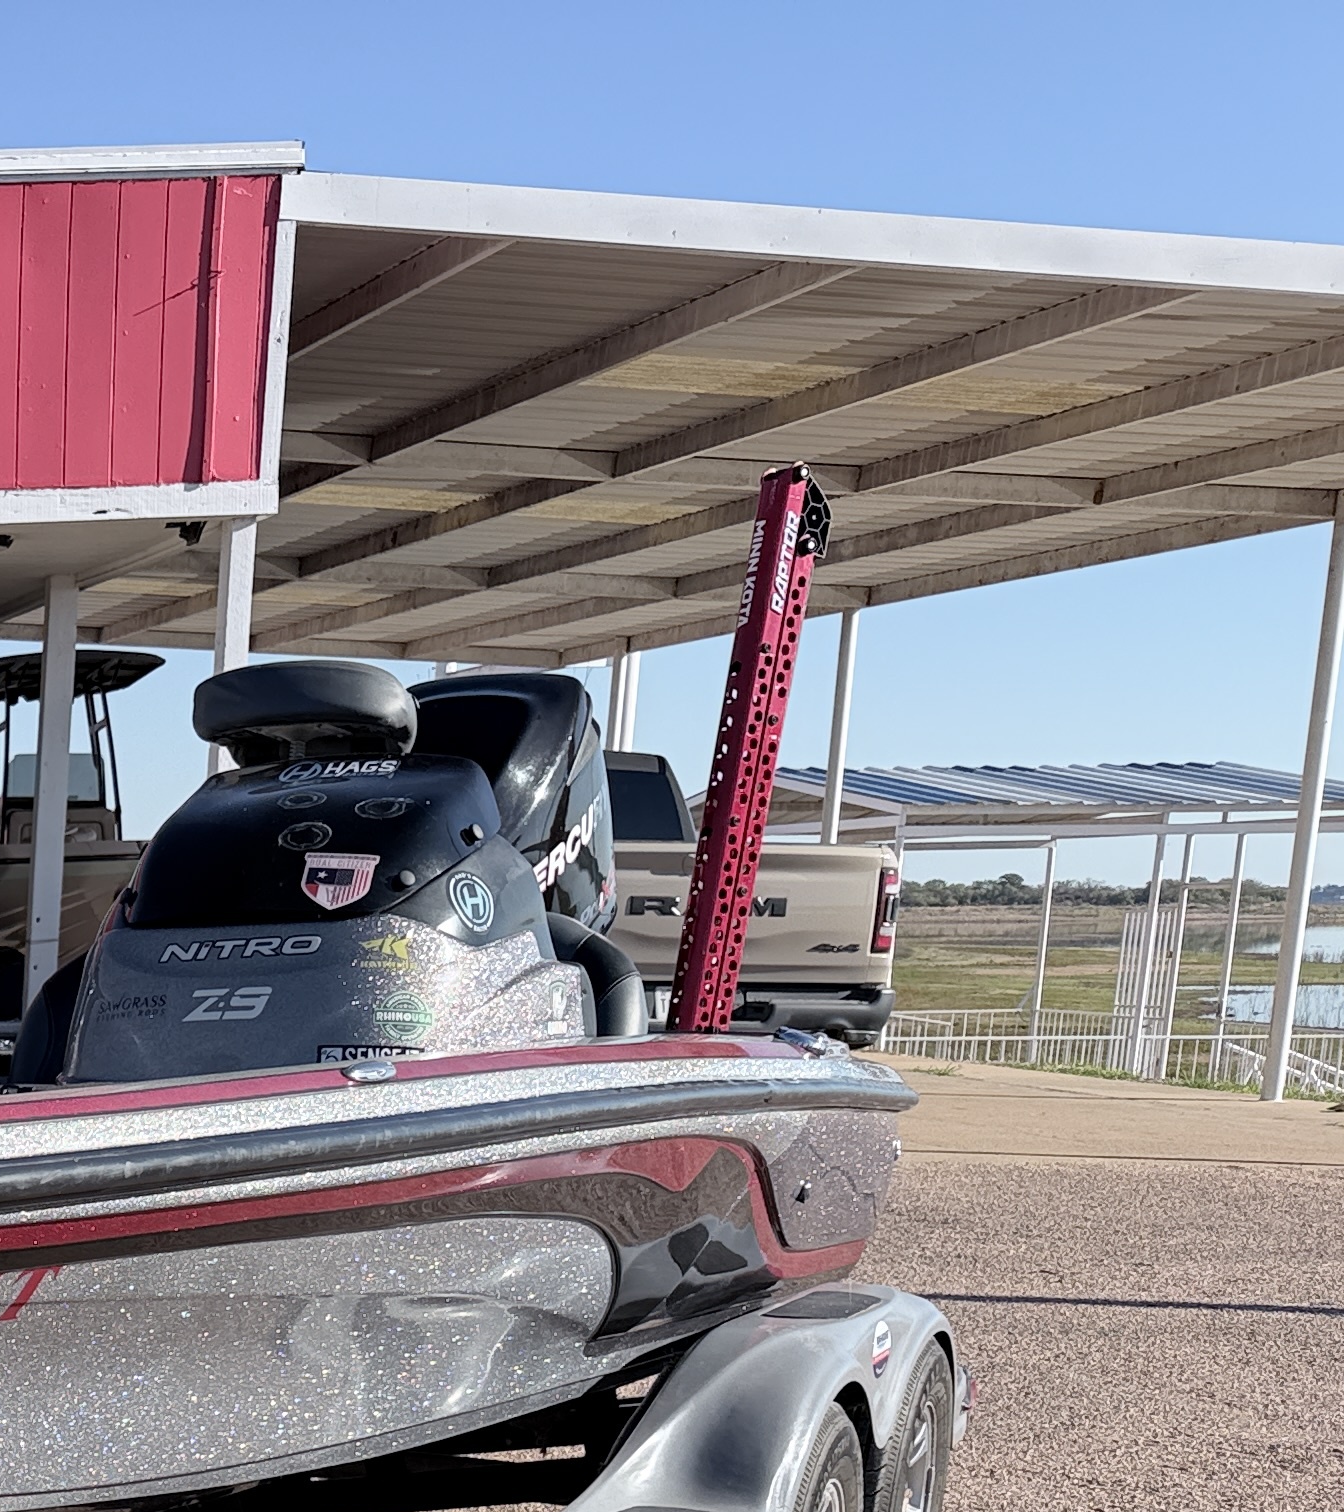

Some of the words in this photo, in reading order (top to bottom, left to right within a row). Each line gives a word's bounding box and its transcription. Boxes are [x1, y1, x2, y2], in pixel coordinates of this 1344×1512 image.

[746, 519, 767, 574] MINN
[770, 510, 801, 615] RAPTOR
[737, 576, 756, 629] KOTA
[324, 759, 399, 777] HAGS
[625, 895, 788, 918] RM
[158, 934, 323, 964] NITRO
[181, 985, 273, 1022] Z9
